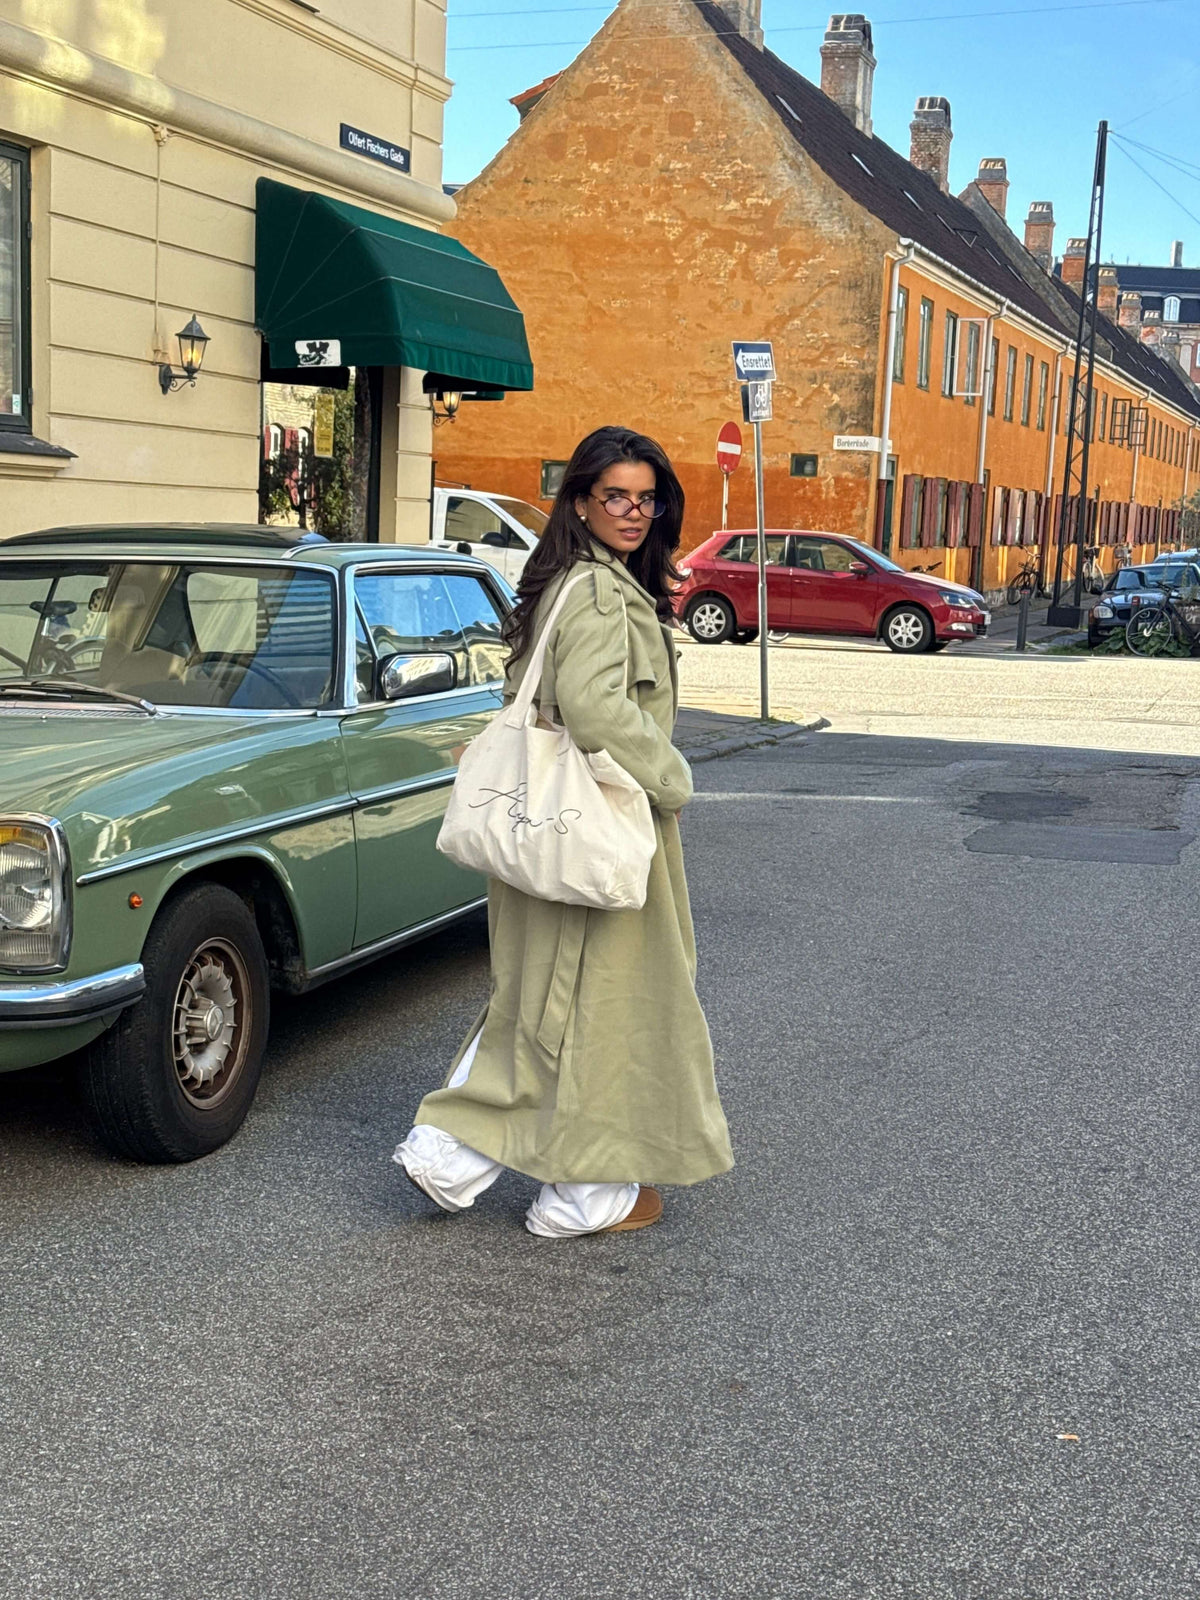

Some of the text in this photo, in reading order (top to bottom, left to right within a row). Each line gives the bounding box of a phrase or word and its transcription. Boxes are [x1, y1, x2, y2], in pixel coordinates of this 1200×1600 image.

[348, 131, 405, 165] Olfert Fischers Gade
[741, 354, 771, 368] Ensrettet
